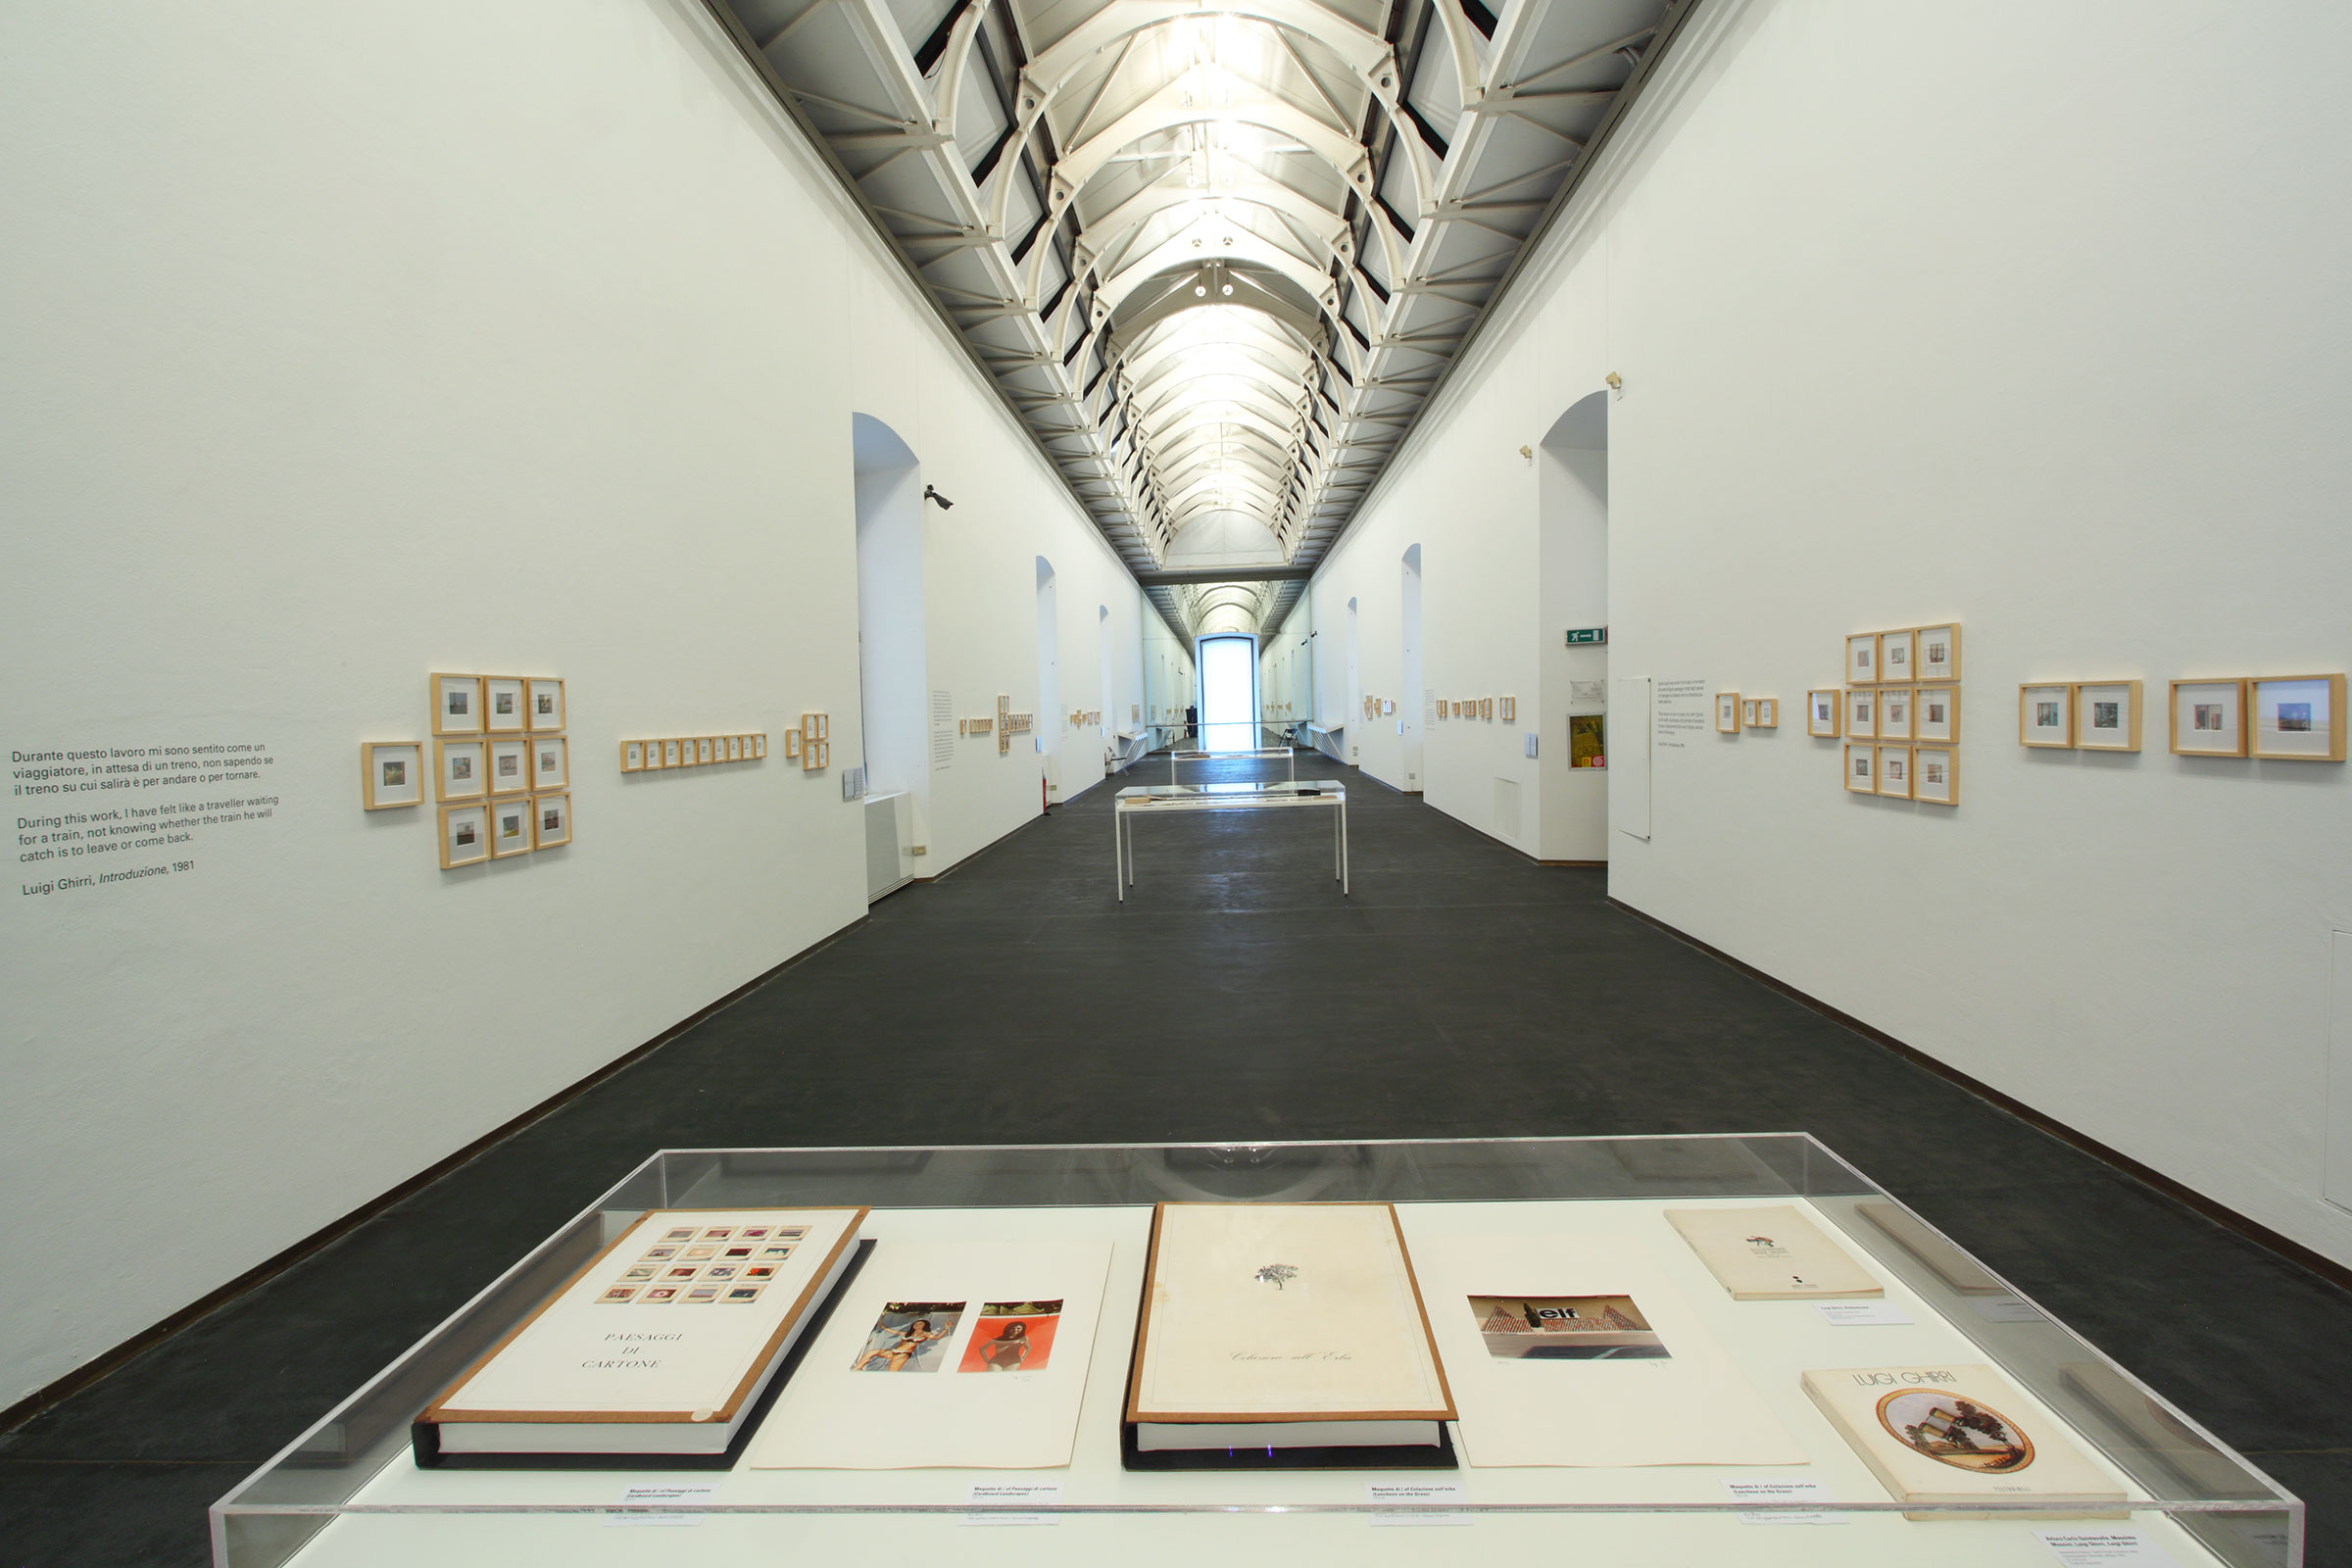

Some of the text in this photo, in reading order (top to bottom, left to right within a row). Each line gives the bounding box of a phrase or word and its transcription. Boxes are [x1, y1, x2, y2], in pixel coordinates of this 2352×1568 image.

[12, 751, 63, 762] Durante
[67, 750, 107, 761] questo
[111, 748, 145, 758] lavoro
[149, 746, 162, 756] mi
[165, 747, 189, 756] sono
[192, 744, 224, 754] sentito
[13, 766, 88, 780] viaggiatore,
[91, 764, 102, 774] in
[106, 764, 139, 773] attesa
[142, 761, 152, 771] di
[223, 756, 262, 767] sapendo
[15, 785, 22, 796] il
[25, 785, 59, 795] treno
[80, 779, 97, 791] cui
[100, 778, 130, 789] salirà
[143, 778, 160, 788] per
[163, 774, 197, 785] andare
[209, 774, 223, 783] per
[225, 771, 261, 780] tornare.
[18, 816, 61, 829] During
[65, 812, 87, 824] this
[90, 809, 122, 821] work,
[131, 808, 157, 817] have
[160, 805, 176, 814] felt
[179, 803, 196, 812] like
[207, 799, 245, 809] traveller
[247, 796, 278, 806] waiting
[19, 834, 37, 846] for
[51, 830, 83, 842] train,
[87, 827, 107, 838] not
[110, 822, 156, 835] knowing
[159, 817, 201, 829] whether
[203, 815, 218, 824] the
[257, 808, 271, 818] will
[20, 832, 193, 862] catch is to leave or come back.
[23, 860, 194, 895] Luigi Ghirri, Introduzione, 1981
[1540, 1308, 1576, 1318] elf
[1852, 1371, 1957, 1386] LUIGI GHIRRI
